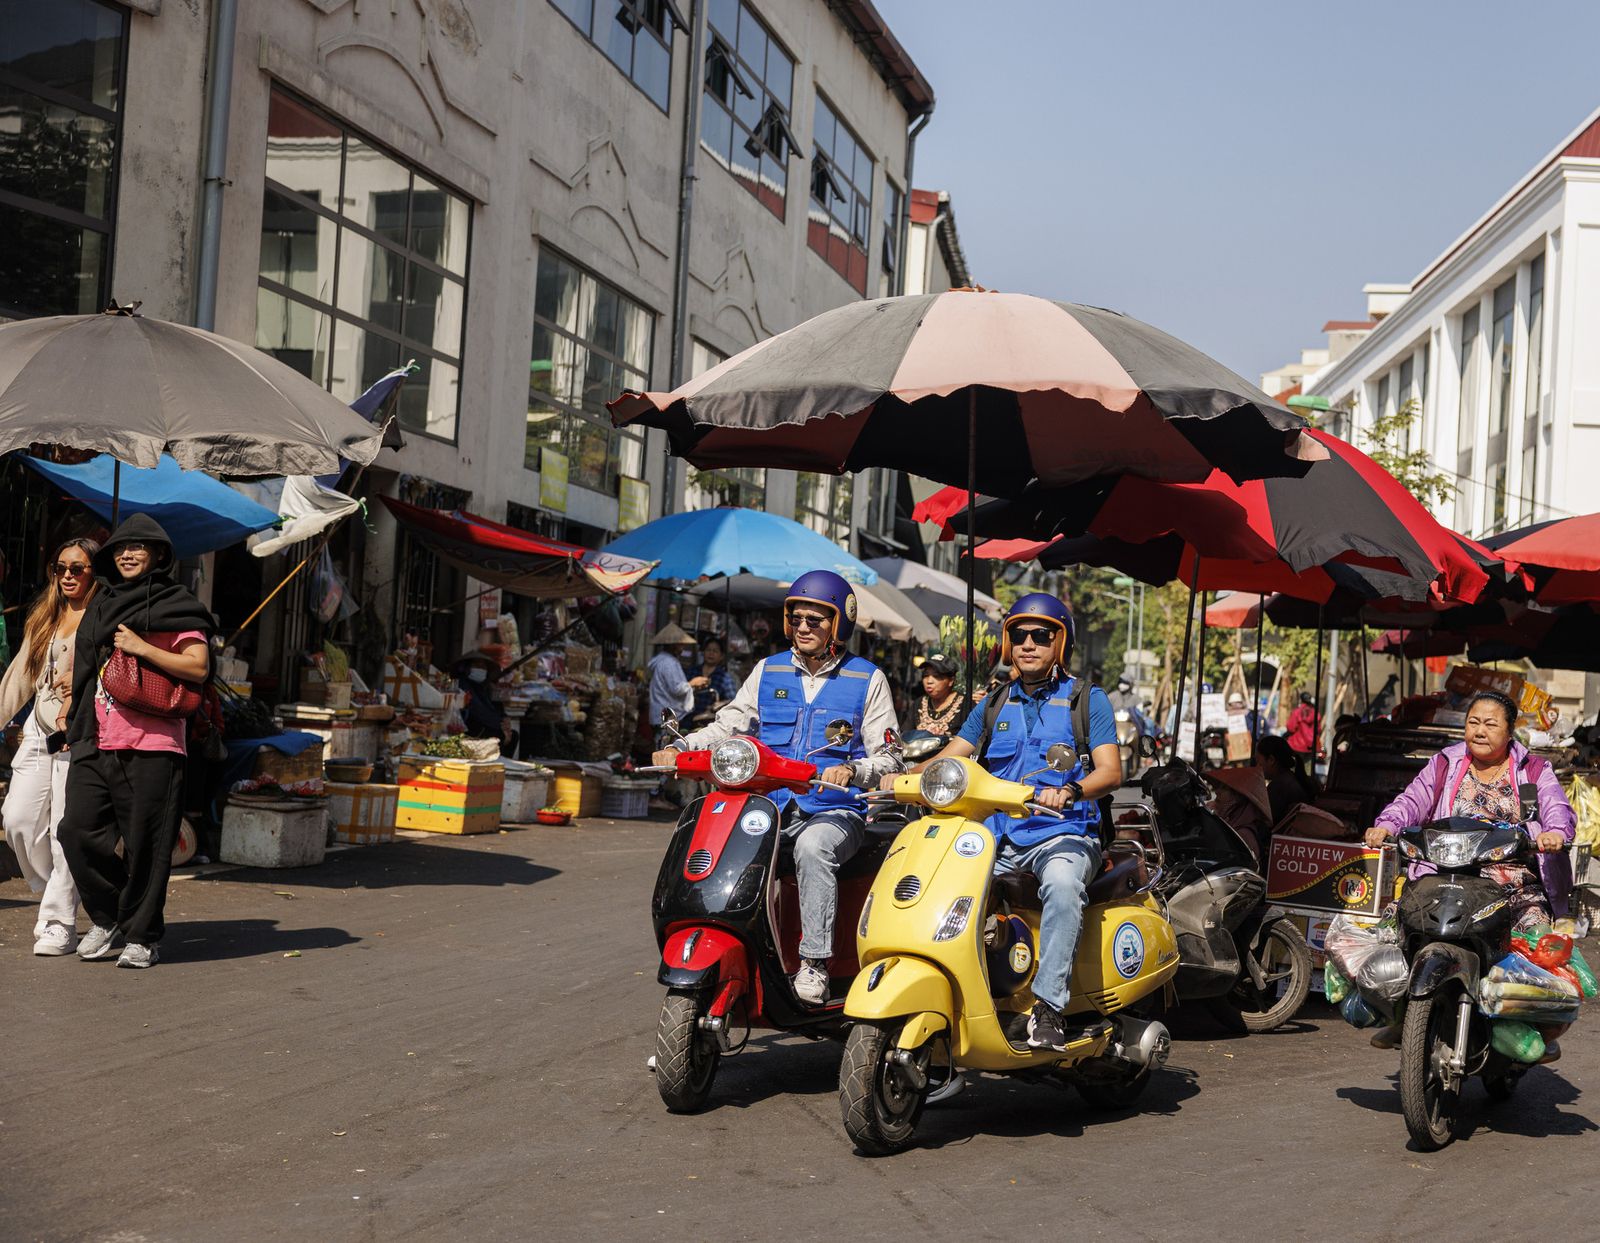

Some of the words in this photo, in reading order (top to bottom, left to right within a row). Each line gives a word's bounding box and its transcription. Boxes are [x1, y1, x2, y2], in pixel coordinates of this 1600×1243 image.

[1273, 844, 1345, 862] FAIRVIEW
[1276, 859, 1319, 875] GOLD
[1331, 867, 1361, 900] CANADIAN
